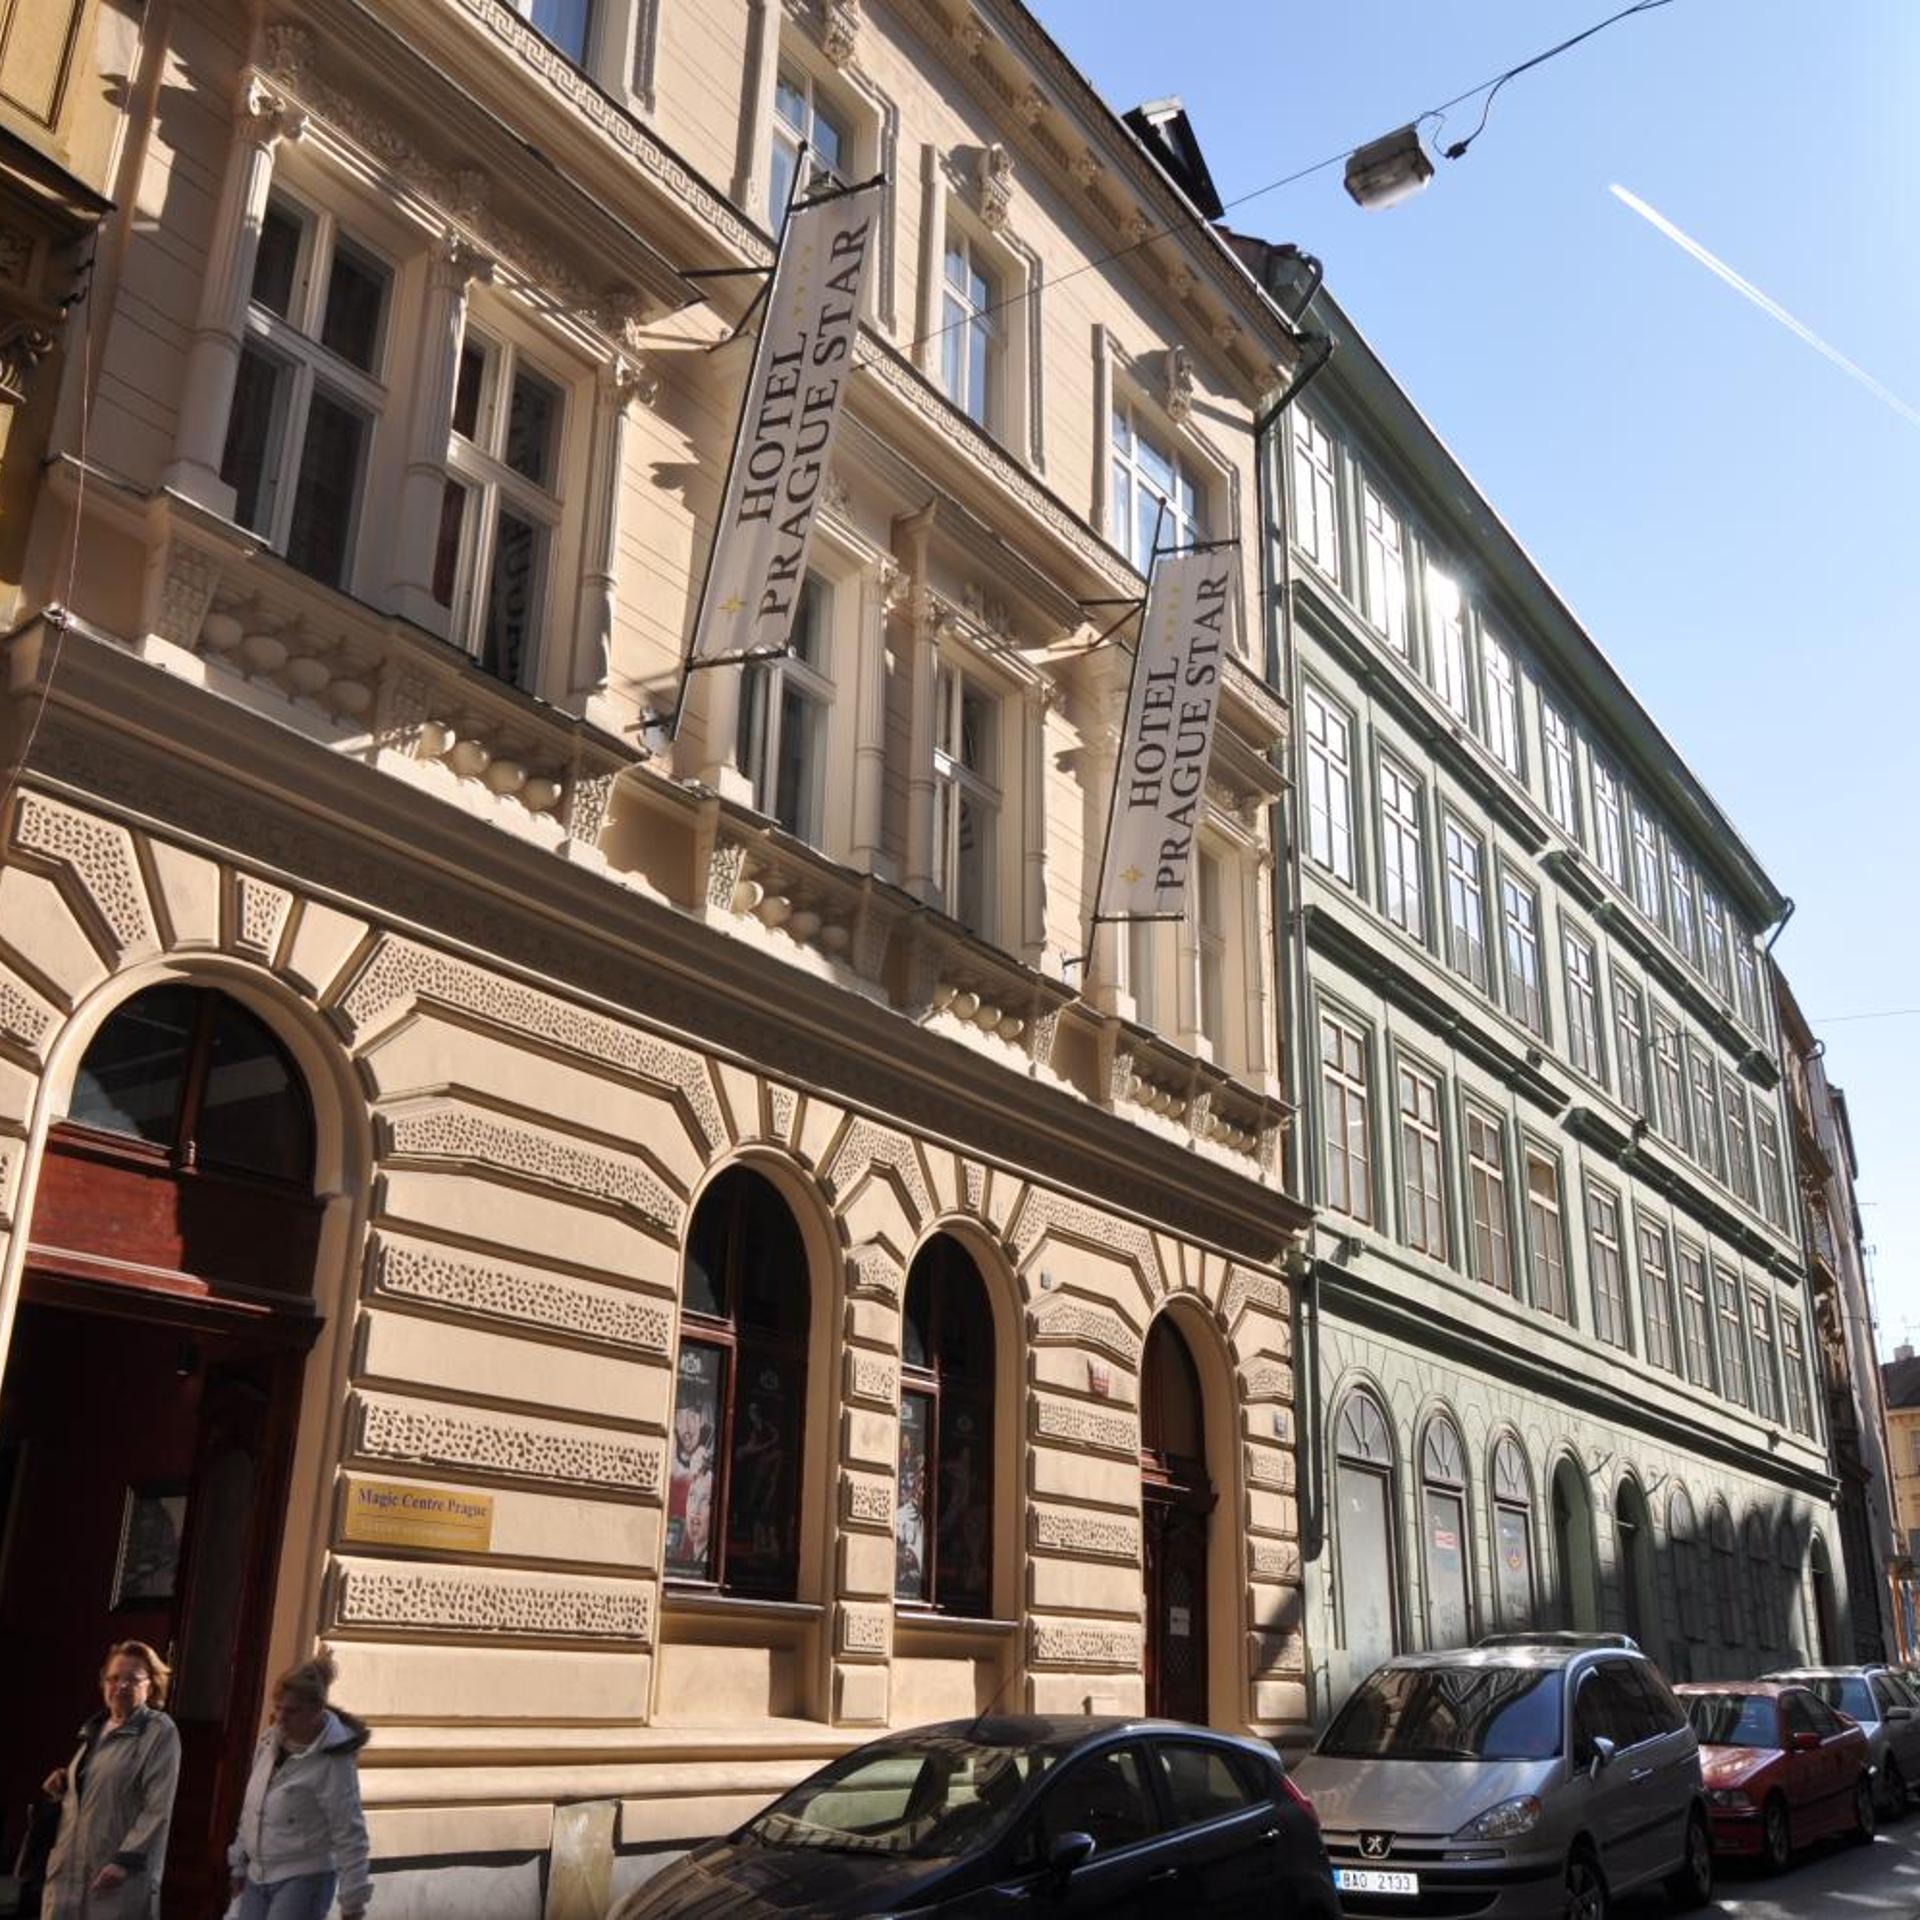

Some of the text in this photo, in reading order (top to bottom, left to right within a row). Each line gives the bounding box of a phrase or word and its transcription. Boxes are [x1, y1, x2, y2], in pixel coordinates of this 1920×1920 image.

[736, 332, 807, 529] HOTEL
[756, 216, 870, 625] PRAGUE STAR
[1128, 657, 1179, 811] HOTEL
[1154, 571, 1229, 893] PRAGUE STAR
[358, 1487, 487, 1518] Magic Centre Prague
